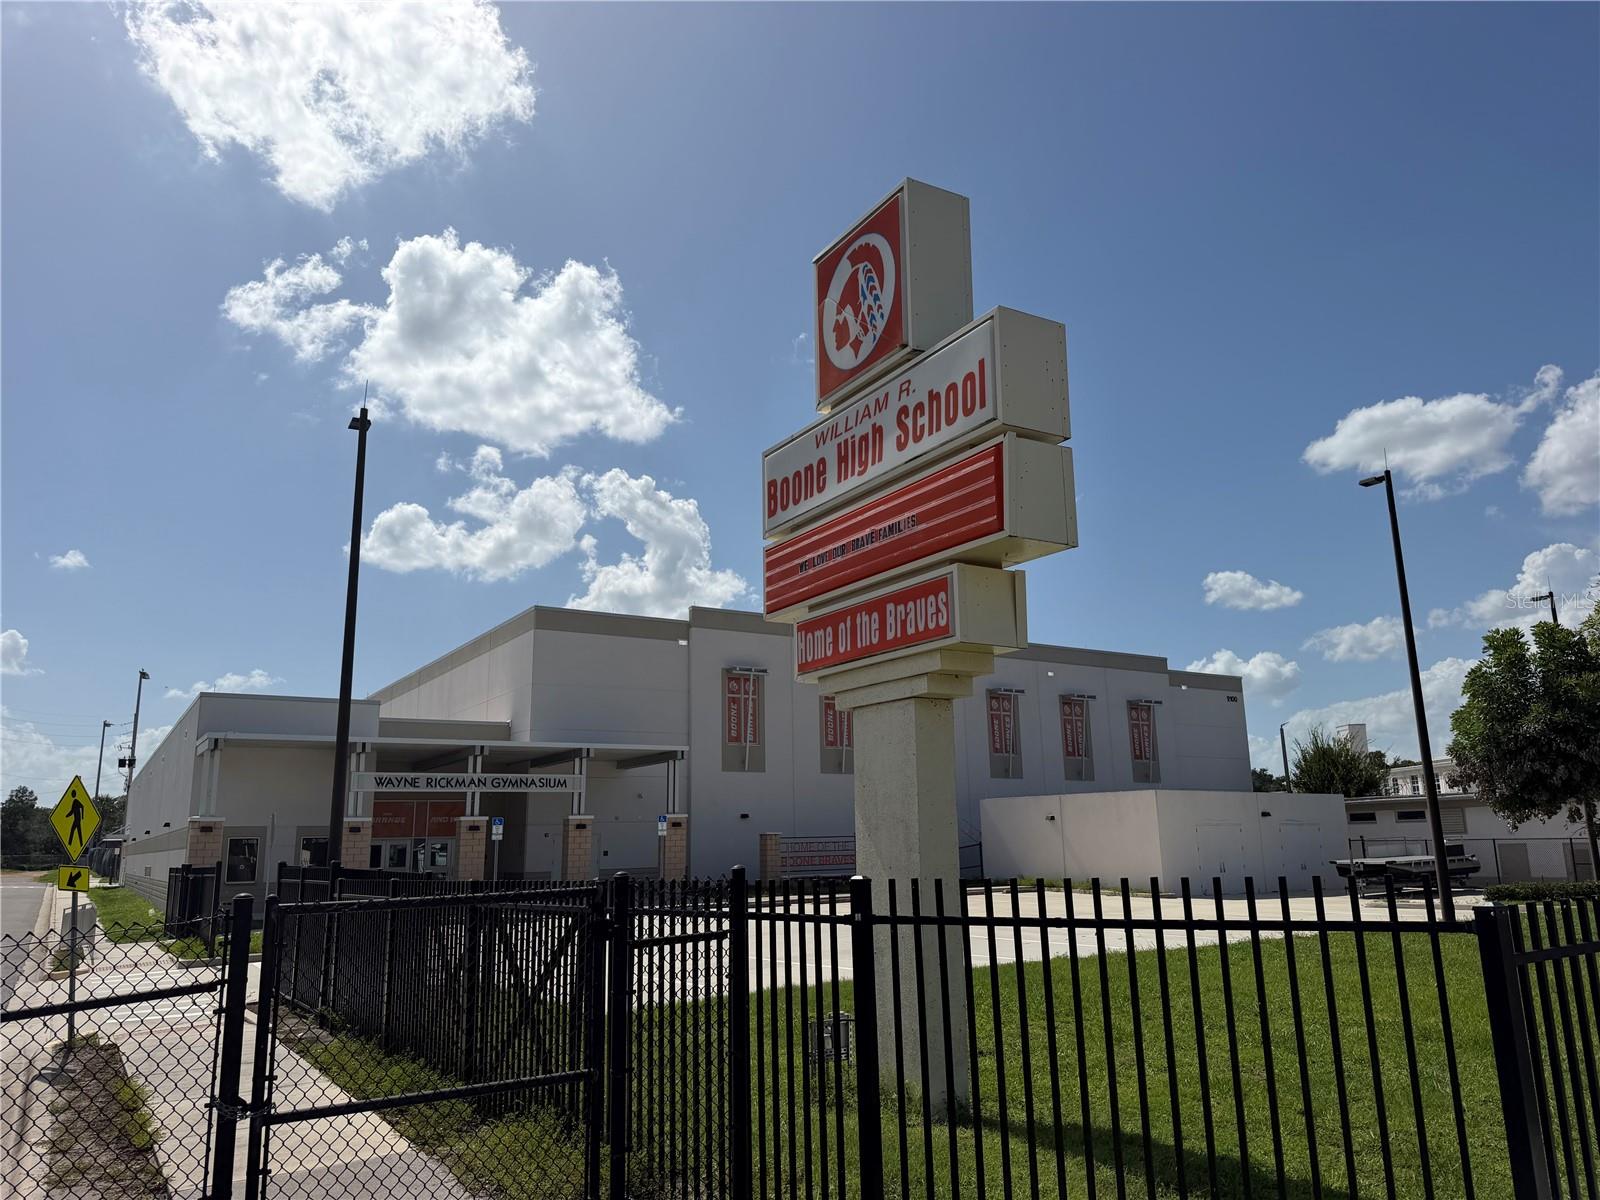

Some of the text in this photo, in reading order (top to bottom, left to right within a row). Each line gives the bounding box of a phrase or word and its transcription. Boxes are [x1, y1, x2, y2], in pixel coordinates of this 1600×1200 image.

[767, 358, 987, 519] Boone High School
[814, 379, 916, 449] WILLIAM R.
[799, 514, 916, 573] WE LOVE OUR BRAVE FAMILIES
[797, 591, 948, 665] Home of the Braves
[730, 702, 738, 737] BOONE
[374, 776, 567, 789] WAYNE RICKMAN GYMNASIUM
